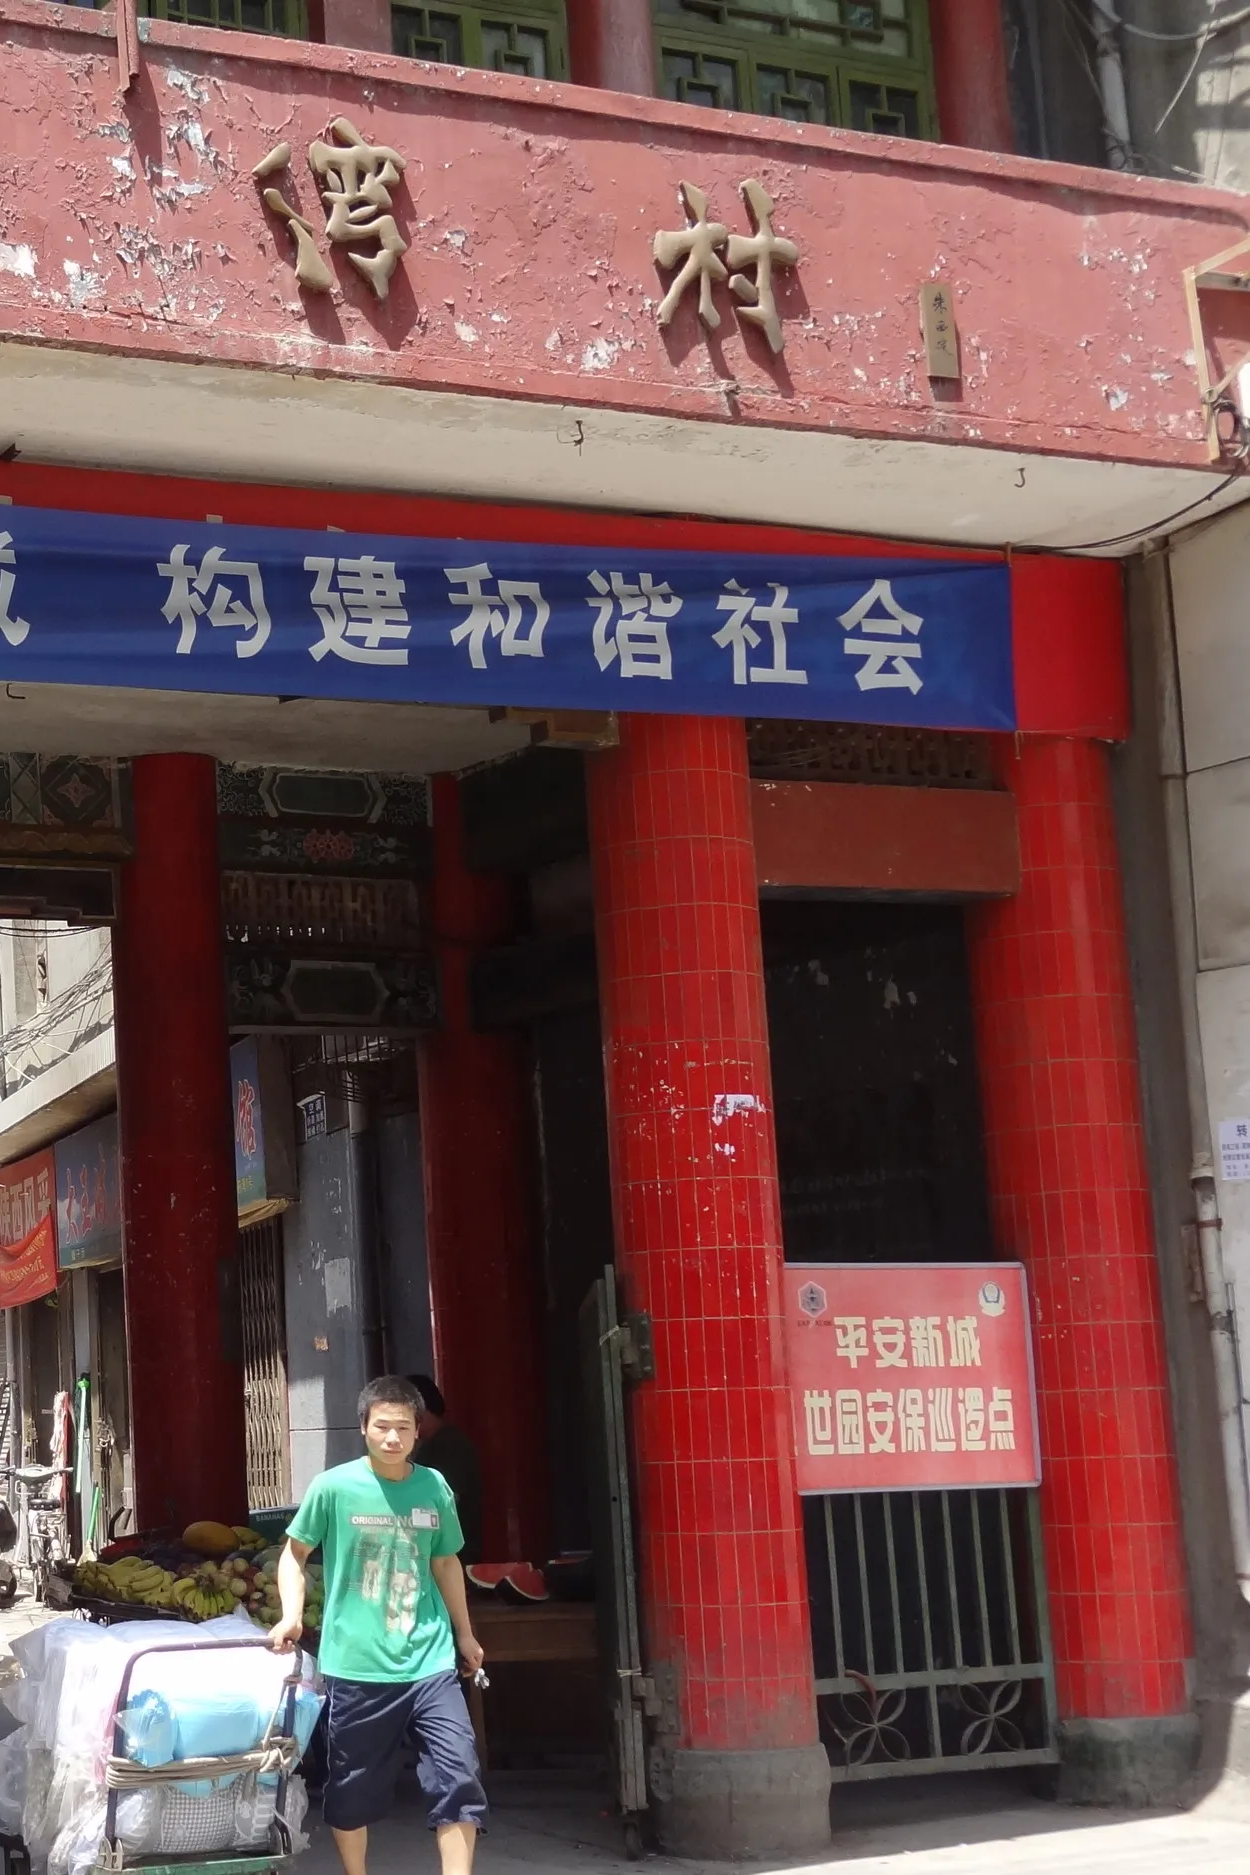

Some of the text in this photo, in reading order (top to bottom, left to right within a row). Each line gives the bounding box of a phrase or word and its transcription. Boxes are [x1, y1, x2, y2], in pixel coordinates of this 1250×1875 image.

[157, 544, 924, 696] 构建和谐社会
[833, 1315, 982, 1369] 平安新城
[803, 1386, 1016, 1456] 世园安保巡逻点
[352, 1515, 393, 1526] ORIGINAL
